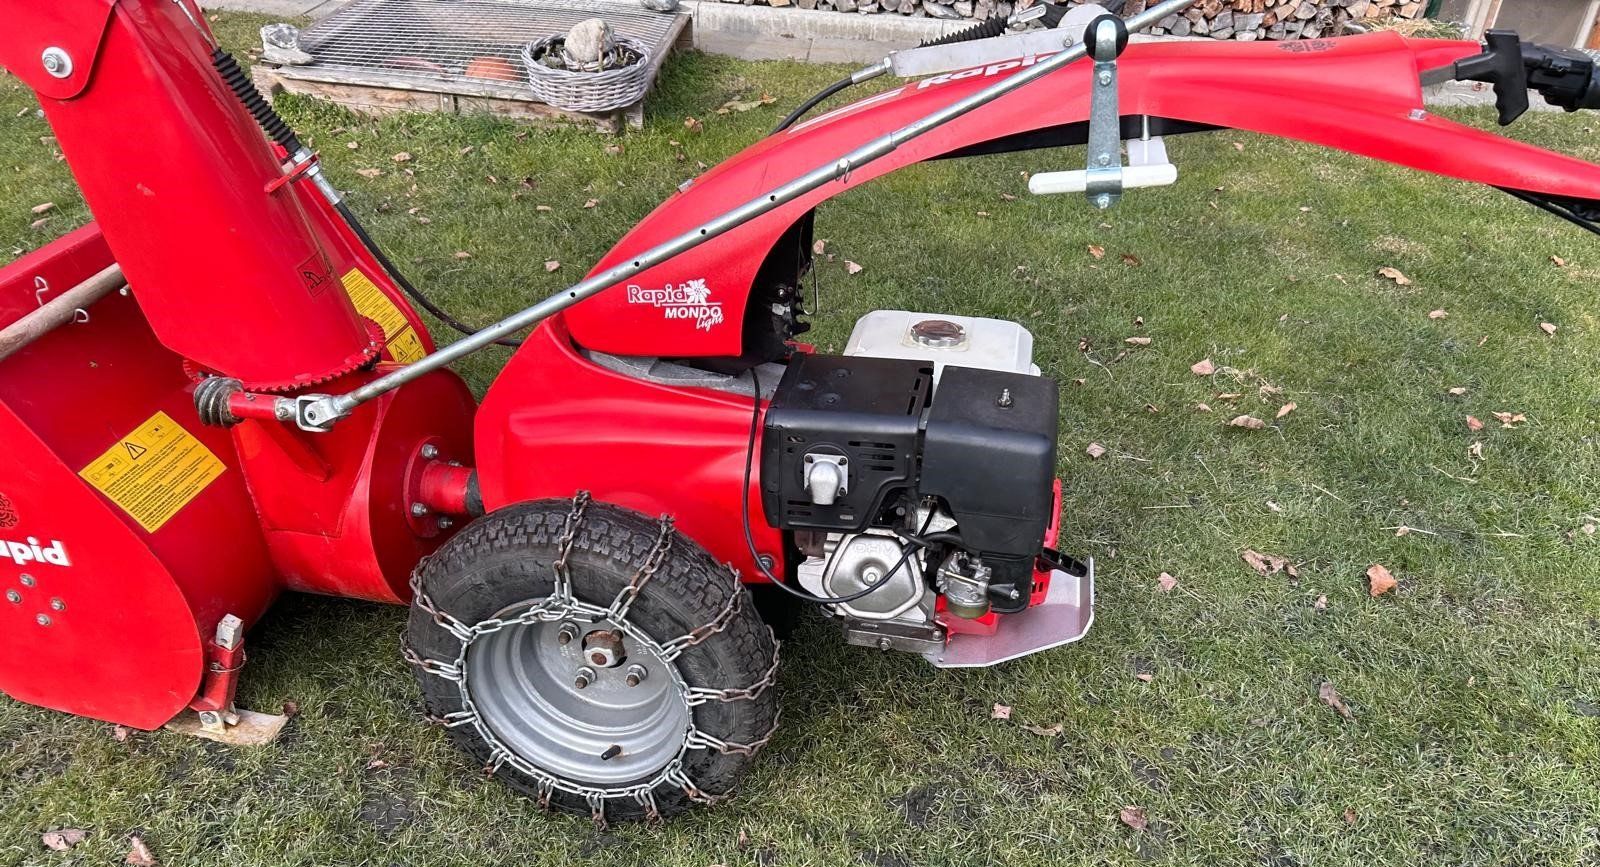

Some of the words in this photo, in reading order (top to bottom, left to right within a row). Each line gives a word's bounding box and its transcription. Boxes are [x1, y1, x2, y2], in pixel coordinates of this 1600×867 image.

[627, 283, 688, 307] Rapid
[664, 306, 722, 319] MONDO
[853, 542, 895, 555] OHV
